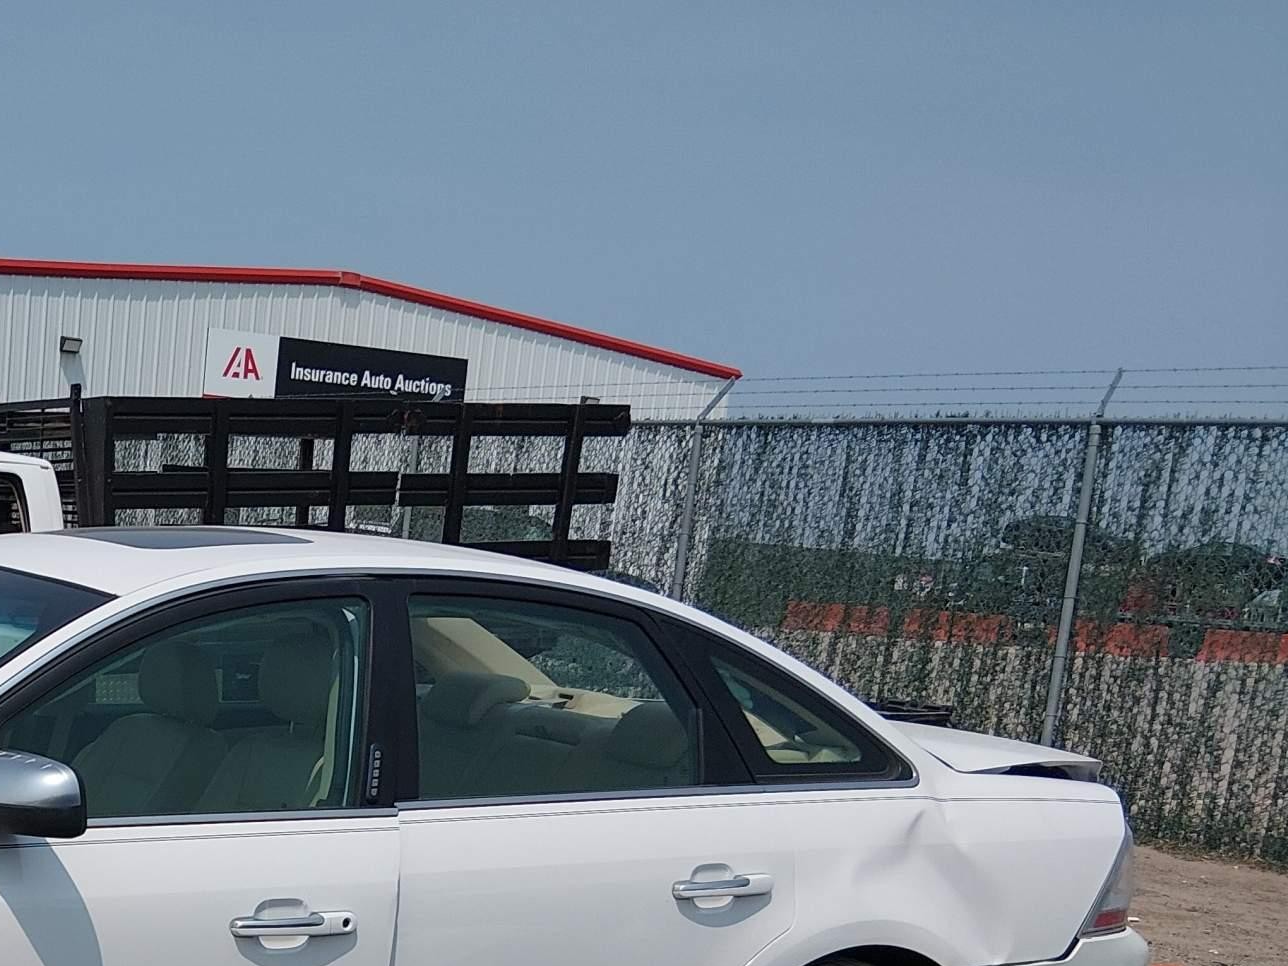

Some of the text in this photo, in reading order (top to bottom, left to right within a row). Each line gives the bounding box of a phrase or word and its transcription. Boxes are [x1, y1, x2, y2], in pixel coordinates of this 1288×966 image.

[290, 361, 452, 397] Insurance Auto Auctions
